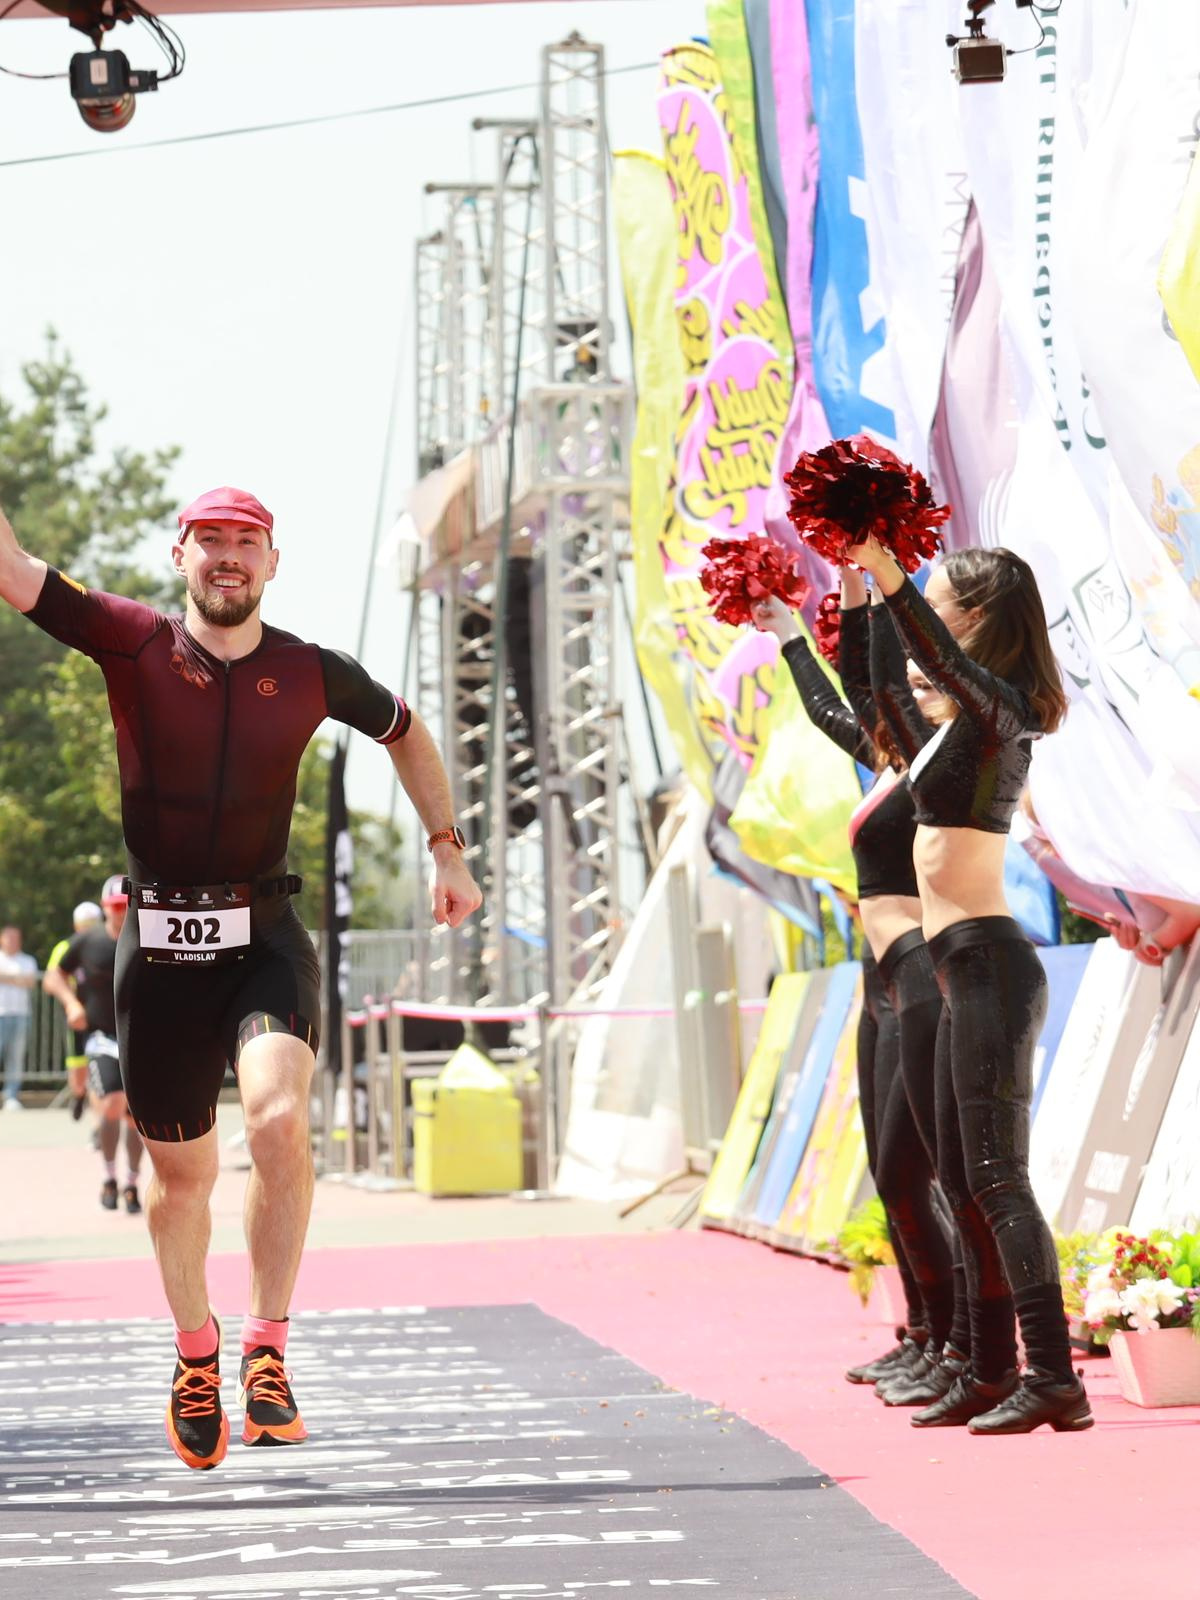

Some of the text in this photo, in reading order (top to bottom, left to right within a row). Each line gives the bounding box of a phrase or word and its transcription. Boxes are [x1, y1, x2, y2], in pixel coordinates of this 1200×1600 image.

[167, 917, 221, 945] 202
[174, 952, 216, 961] VLADISLAV
[343, 1529, 687, 1549] STAR
